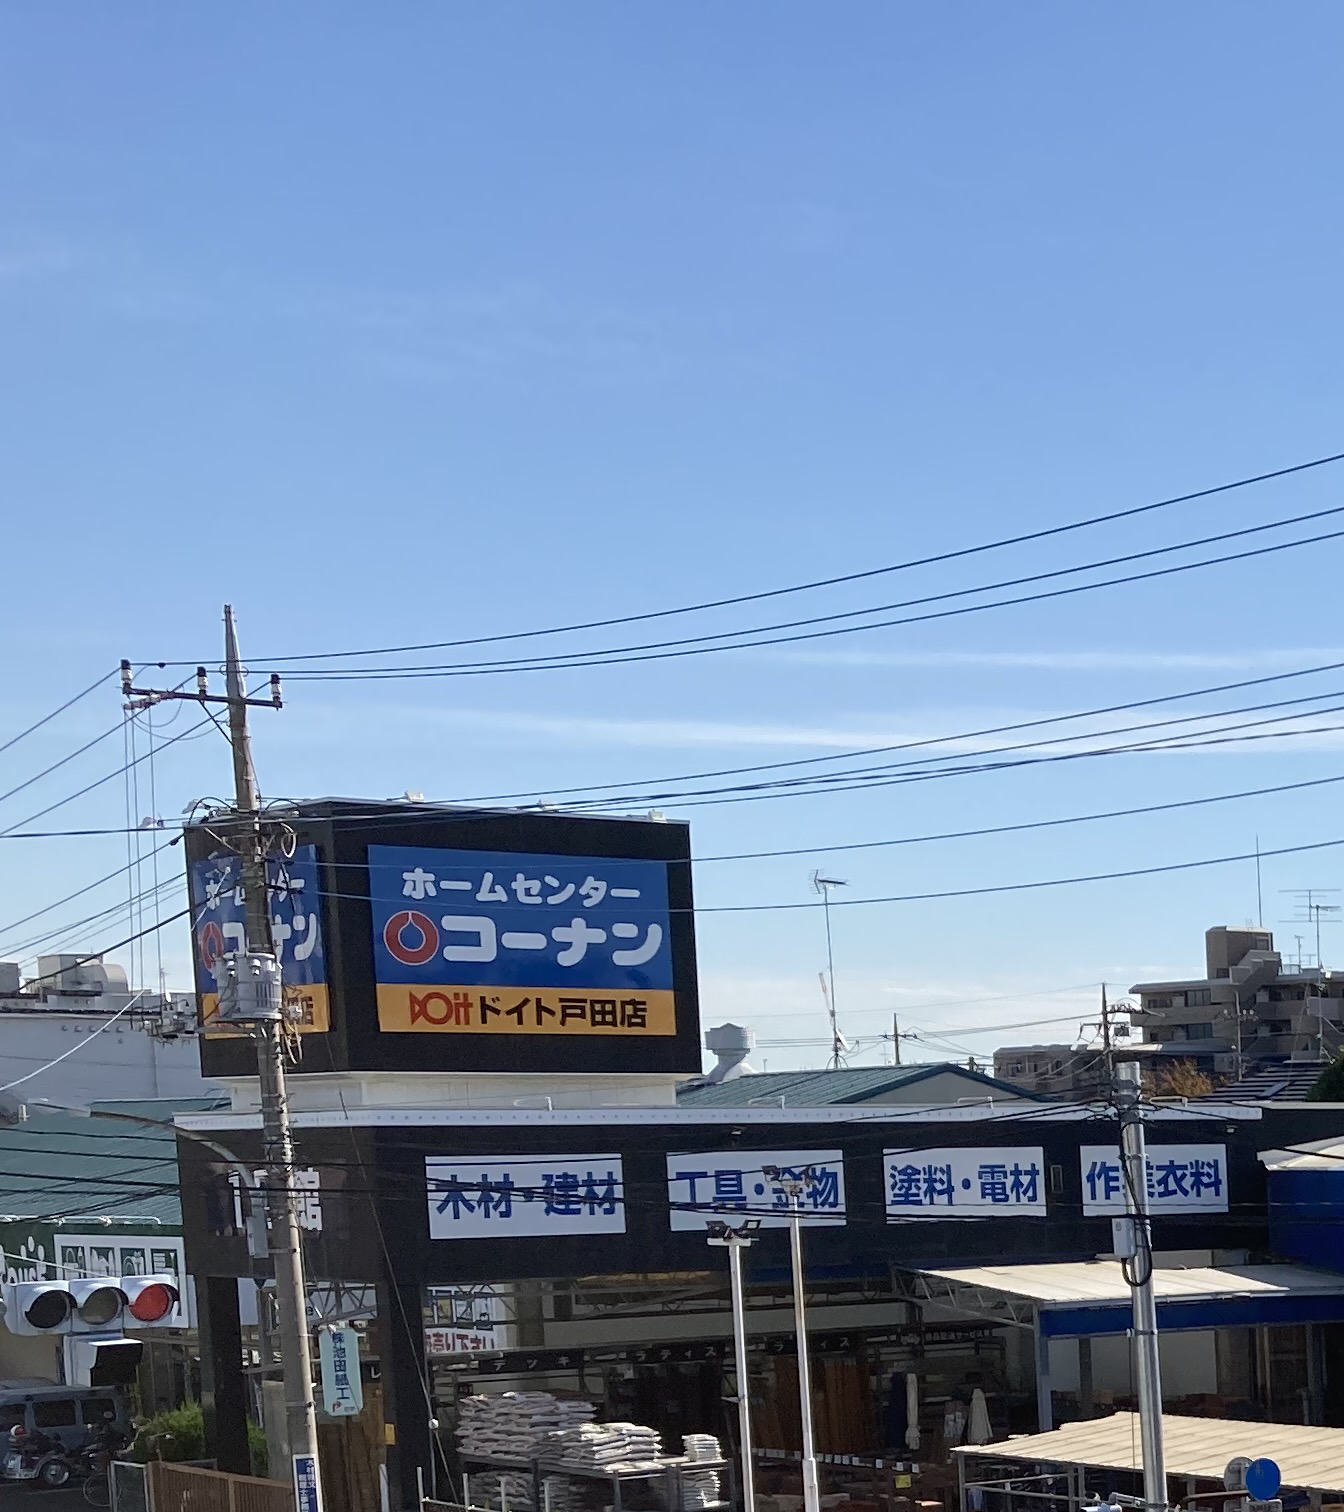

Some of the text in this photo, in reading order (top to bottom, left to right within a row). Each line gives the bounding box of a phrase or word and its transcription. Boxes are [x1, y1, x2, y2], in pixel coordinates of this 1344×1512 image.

[402, 867, 641, 908] ホームセンター
[441, 915, 663, 967] コーナン
[480, 996, 648, 1028] ドイト戸田店
[436, 1171, 623, 1219] 木材・建材
[889, 1162, 1041, 1205] 塗料・電材
